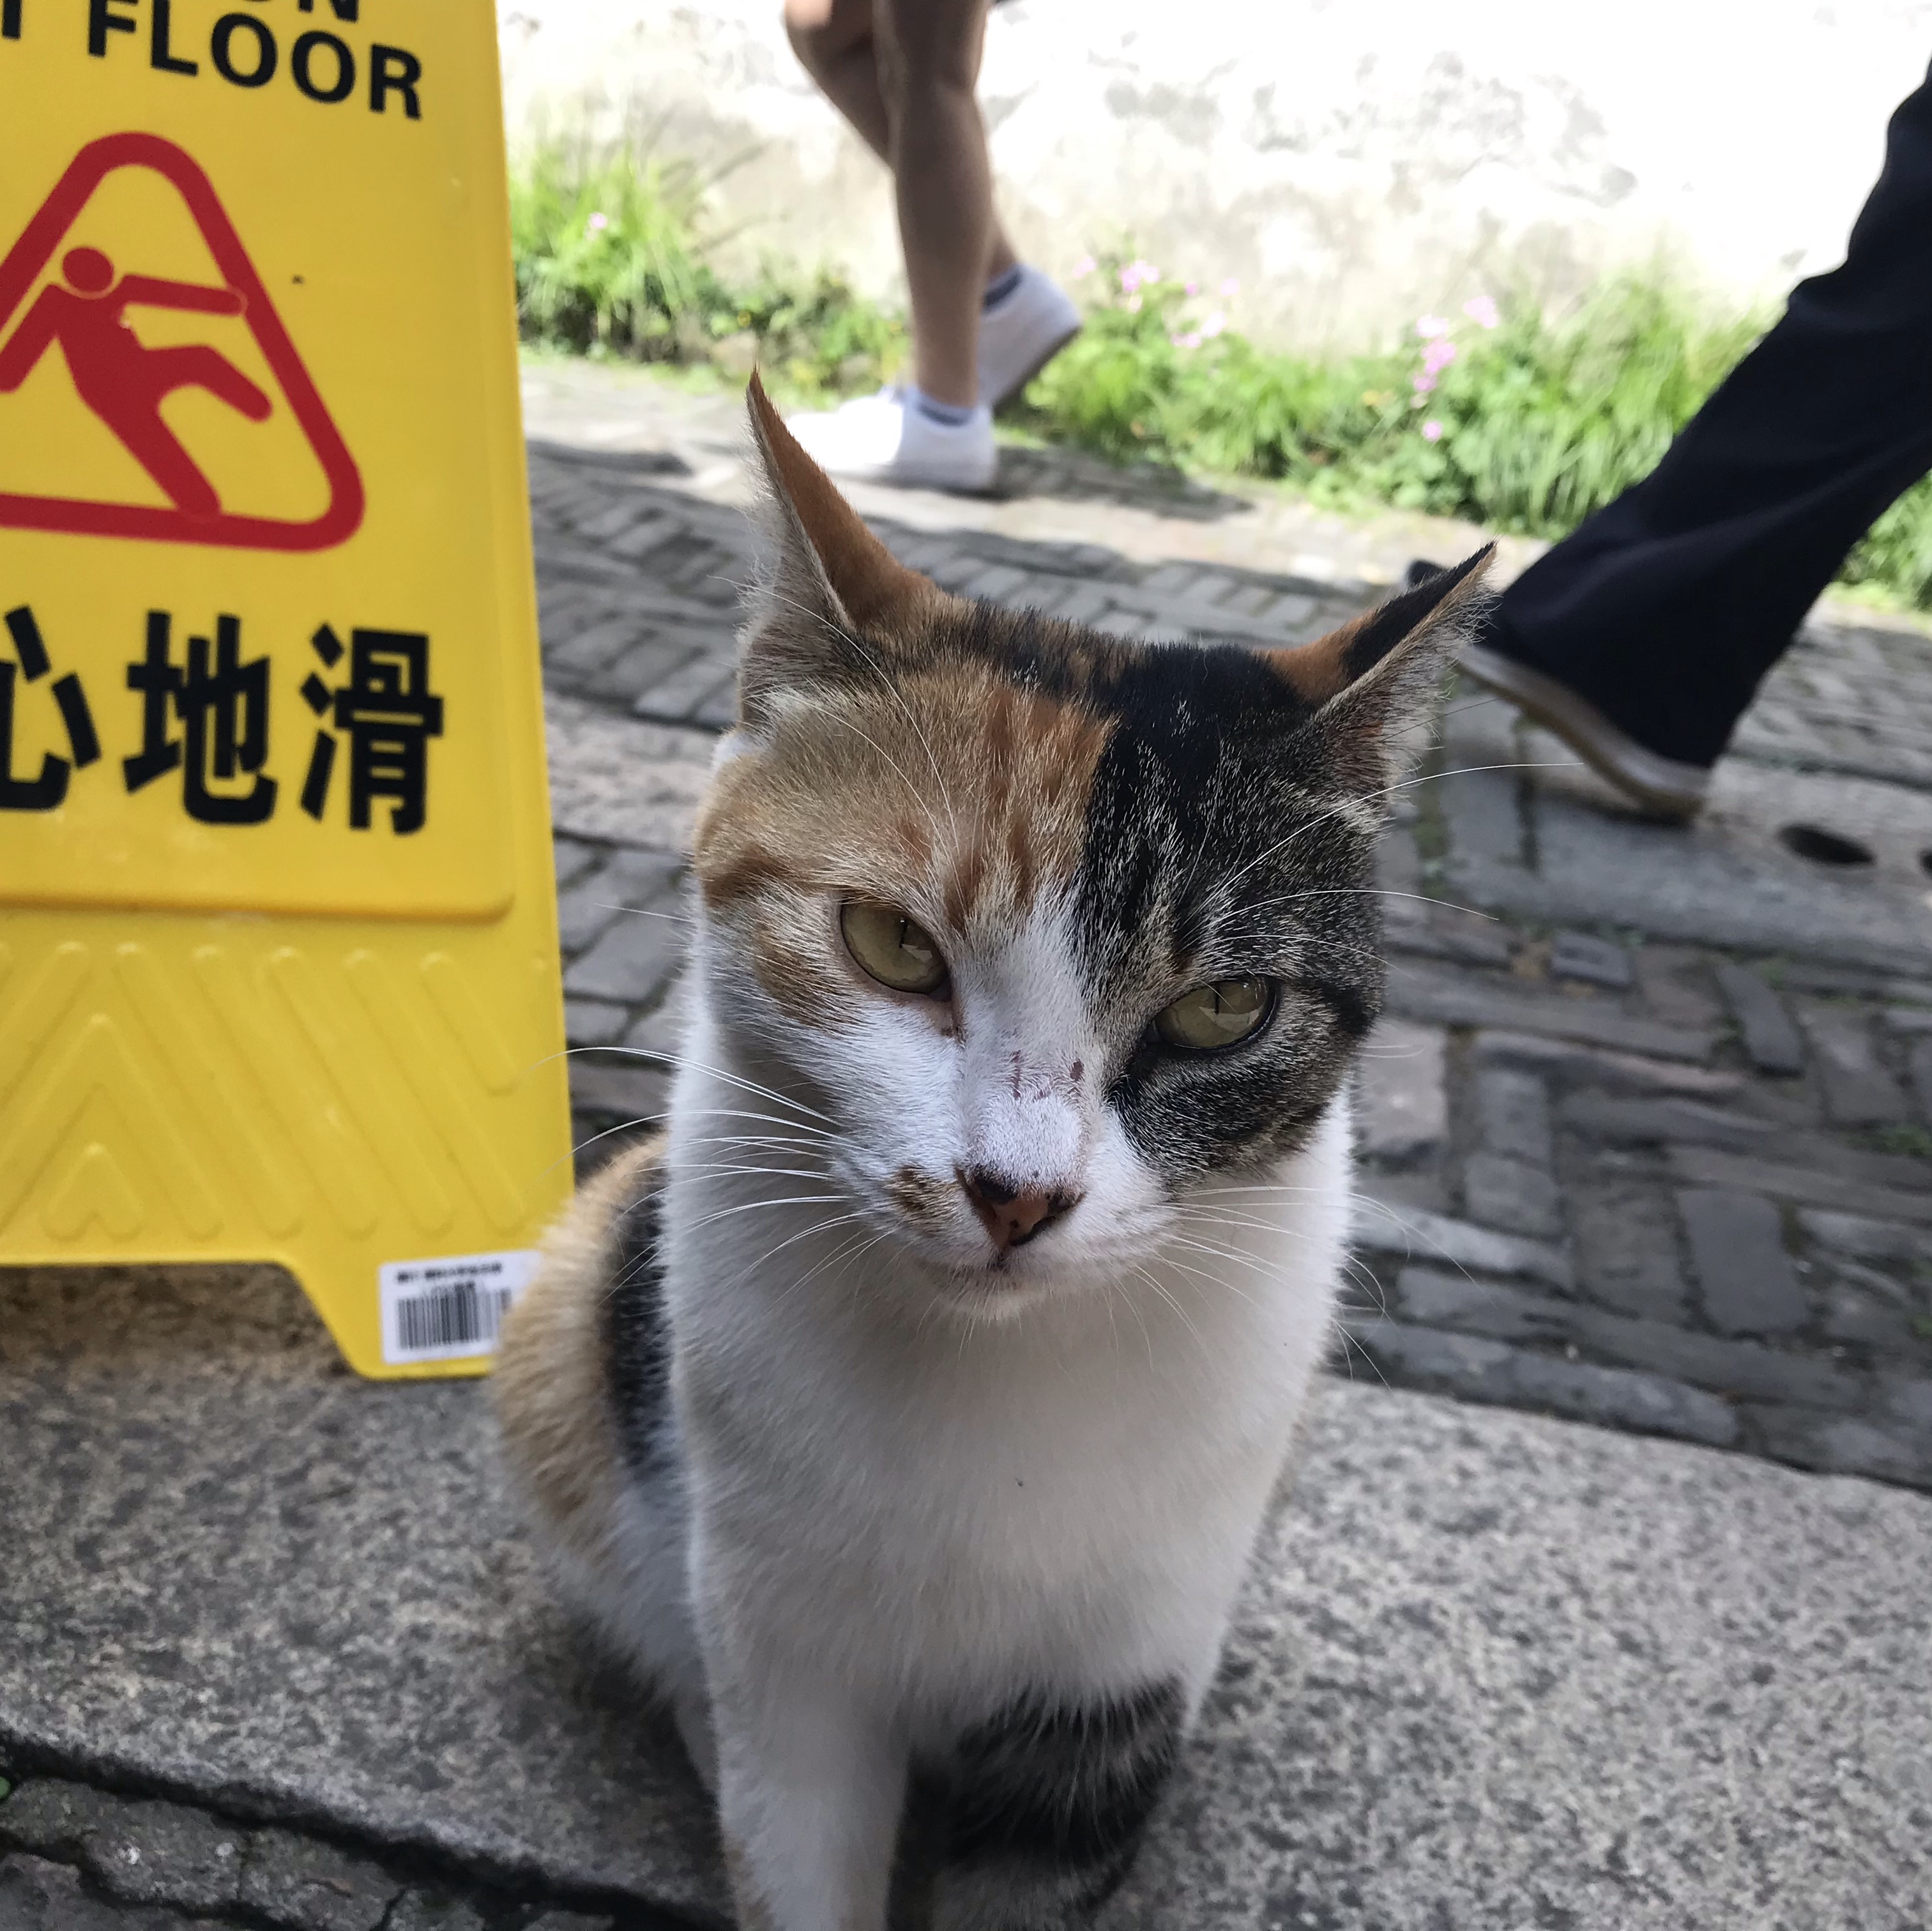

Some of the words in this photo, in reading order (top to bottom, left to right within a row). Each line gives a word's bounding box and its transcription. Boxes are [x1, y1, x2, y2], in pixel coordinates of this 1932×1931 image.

[88, 0, 422, 120] FLOOR
[0, 605, 444, 835] 心地滑
